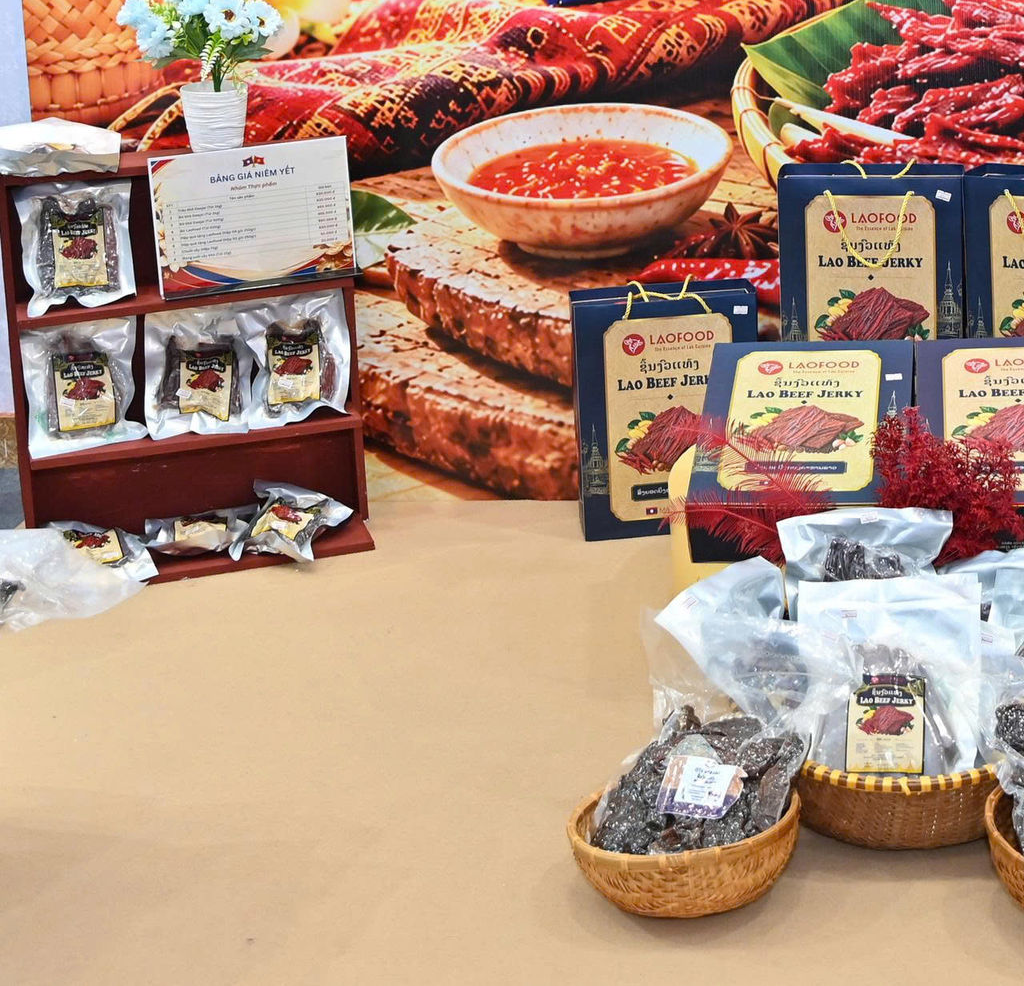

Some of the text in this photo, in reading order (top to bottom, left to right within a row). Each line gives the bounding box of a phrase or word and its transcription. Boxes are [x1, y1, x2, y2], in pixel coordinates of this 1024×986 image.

[851, 212, 917, 224] LAOFOOD
[818, 255, 844, 267] LAO
[649, 330, 714, 345] LAOFOOD
[788, 361, 860, 369] LAOFOOD
[617, 374, 710, 391] LAO BEEF JER
[747, 389, 864, 398] LAO BEEF JERKY
[959, 389, 987, 398] LAO
[891, 697, 914, 705] JERKY
